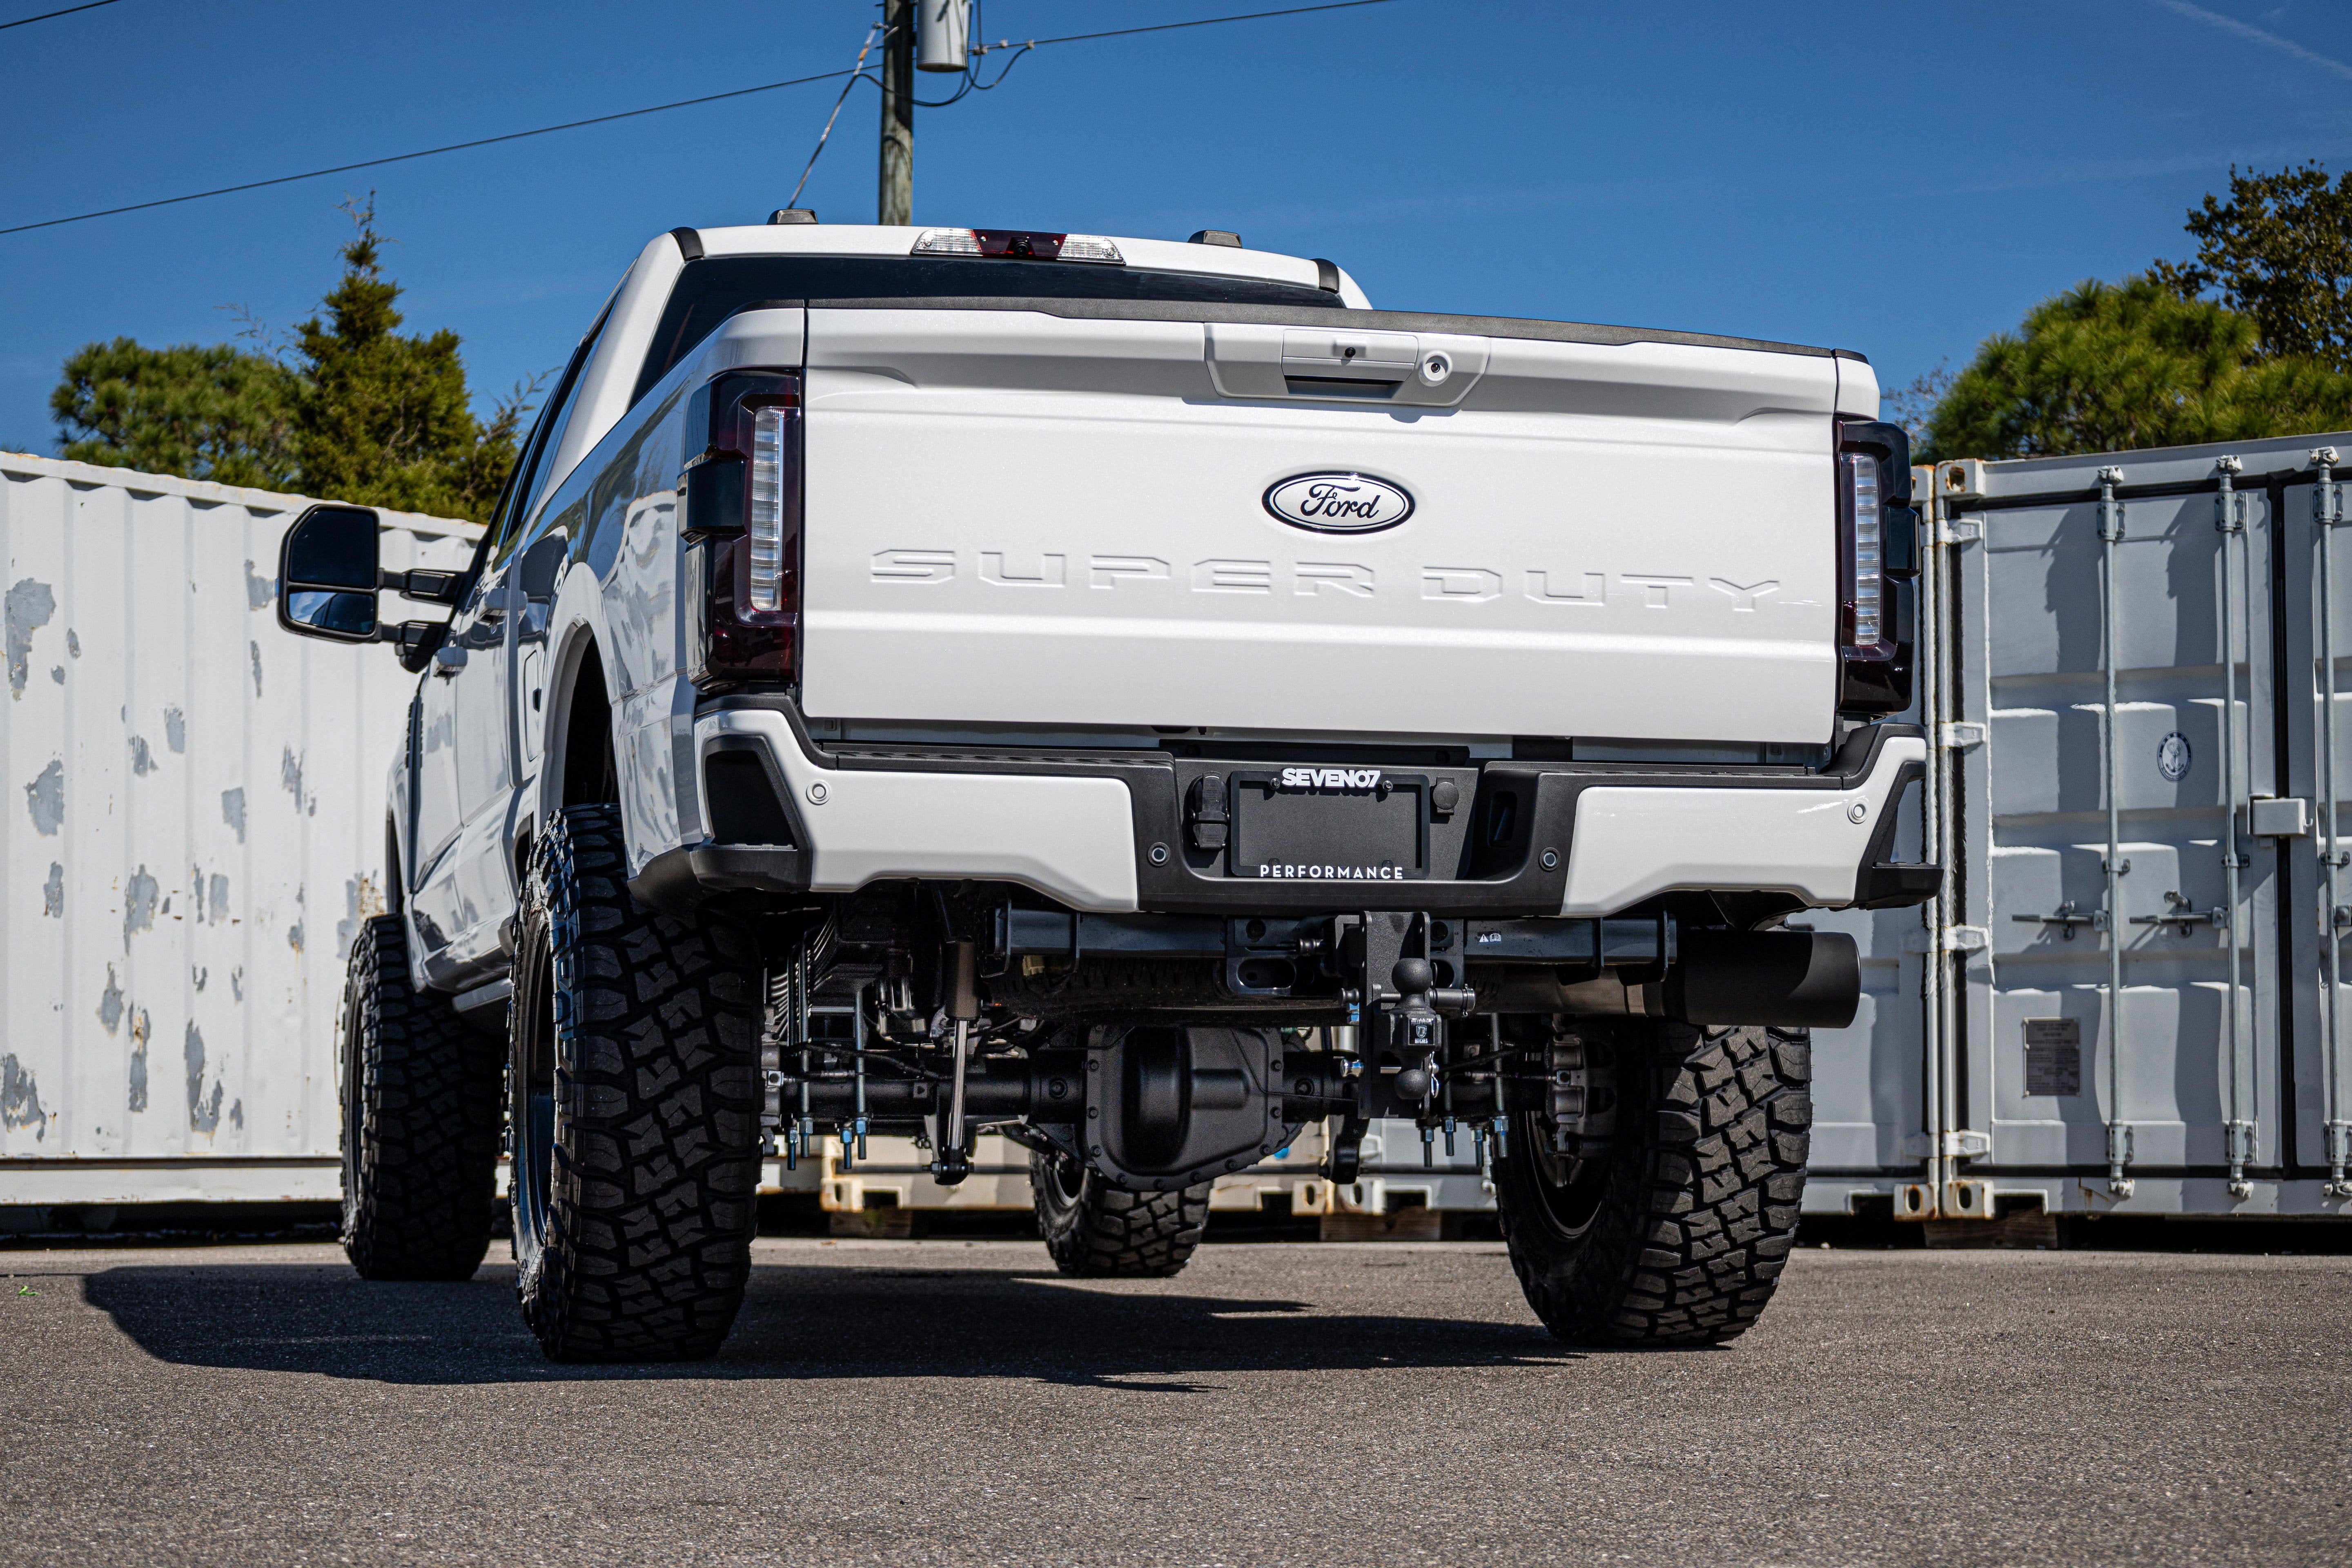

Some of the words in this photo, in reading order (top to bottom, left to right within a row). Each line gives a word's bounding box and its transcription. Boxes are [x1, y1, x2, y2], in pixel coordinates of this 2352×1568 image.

[1300, 483, 1381, 519] Ford
[870, 549, 1374, 598] SUPER
[1421, 566, 1780, 612] DUTY
[1260, 864, 1403, 879] PERFORMANCE
